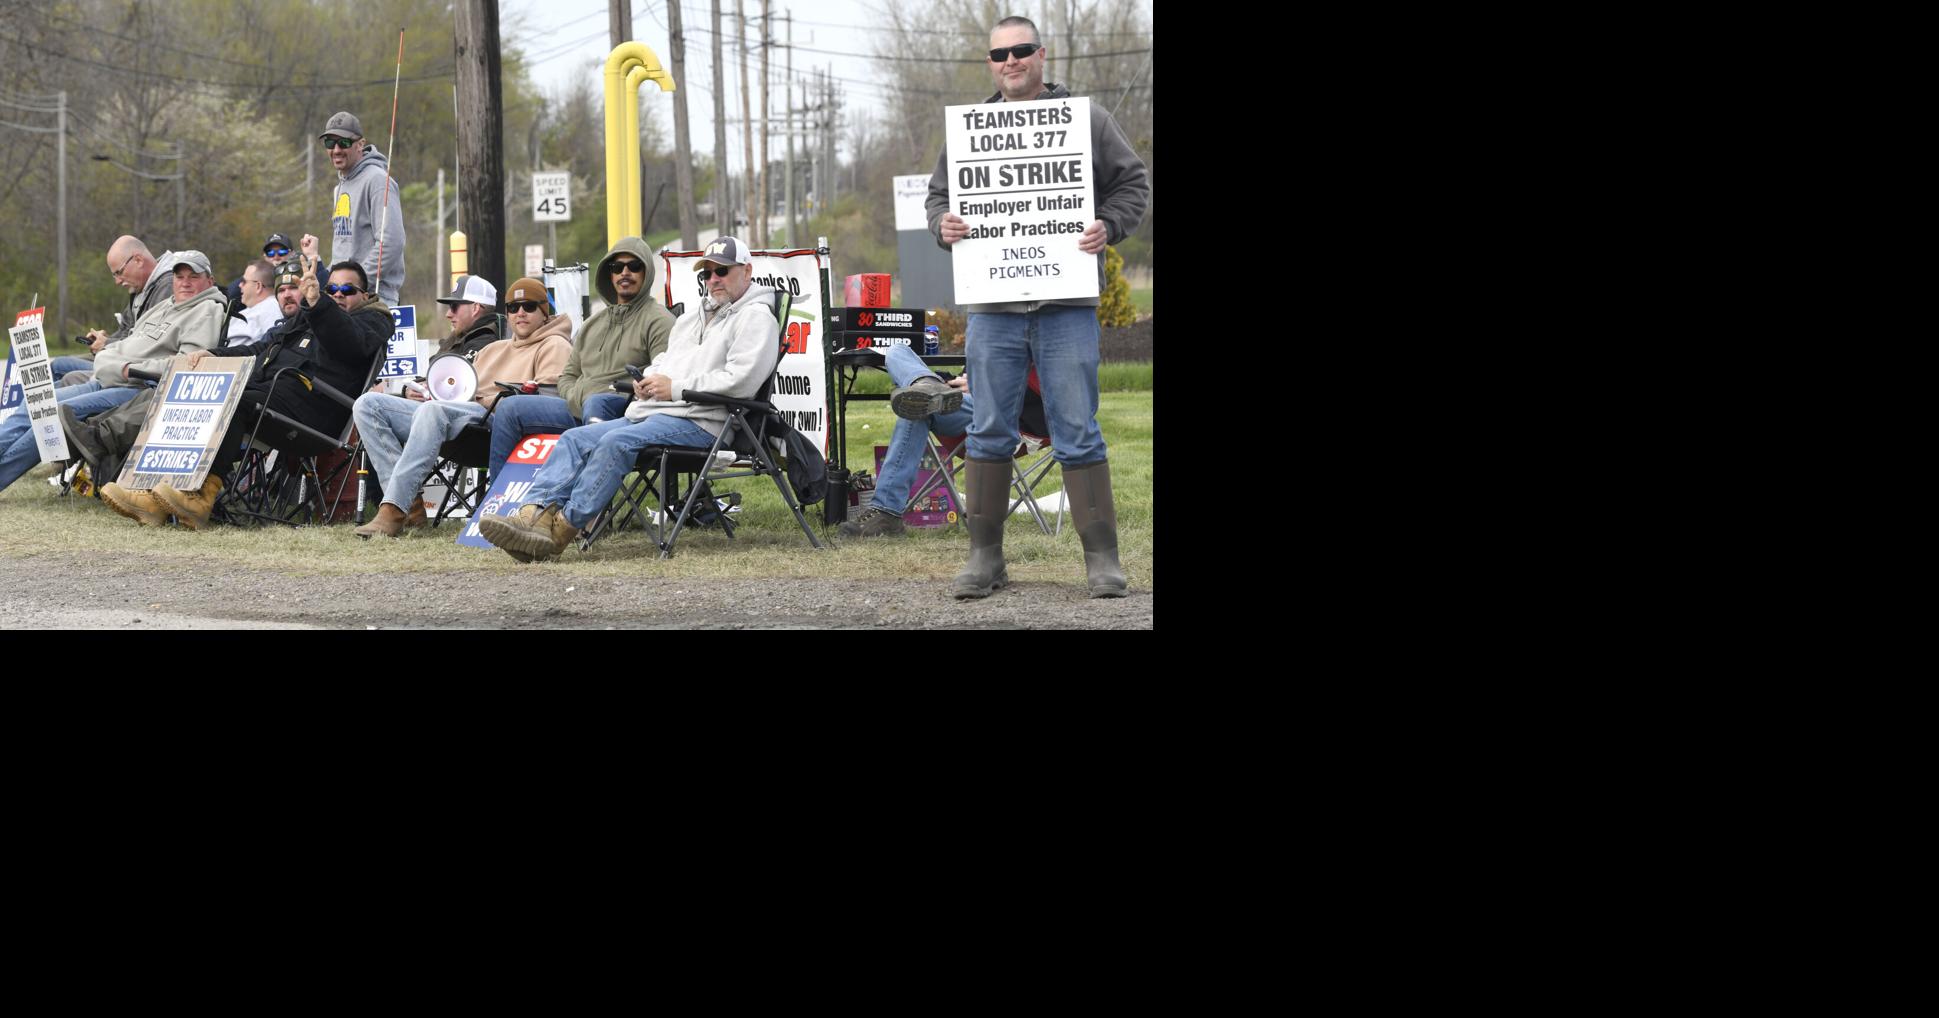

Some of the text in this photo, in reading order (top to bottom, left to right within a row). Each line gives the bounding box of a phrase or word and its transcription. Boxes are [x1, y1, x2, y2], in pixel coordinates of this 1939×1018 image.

[963, 107, 1072, 130] TEAMSTERS
[970, 130, 1067, 152] LOCAL 377
[535, 178, 566, 187] SPEED
[958, 160, 1083, 189] ON STRIKE
[539, 187, 562, 196] LIMIT
[537, 198, 567, 215] 45
[959, 194, 1085, 218] Employer Unfair
[1011, 220, 1084, 237] Practices
[1002, 246, 1046, 260] INEOS
[989, 263, 1061, 279] PIGMENTS
[858, 312, 913, 327] 30 THIRD
[13, 328, 40, 345] TEAMSTERS
[18, 345, 33, 361] LOCAL
[21, 368, 31, 386] ON
[30, 363, 50, 383] STRIKE
[174, 375, 225, 401] ICWUC
[777, 371, 811, 396] home
[162, 408, 214, 423] UNFAIR LABOR
[161, 426, 200, 440] PRACTICE
[517, 437, 560, 460] ST
[150, 450, 192, 469] STRIKE
